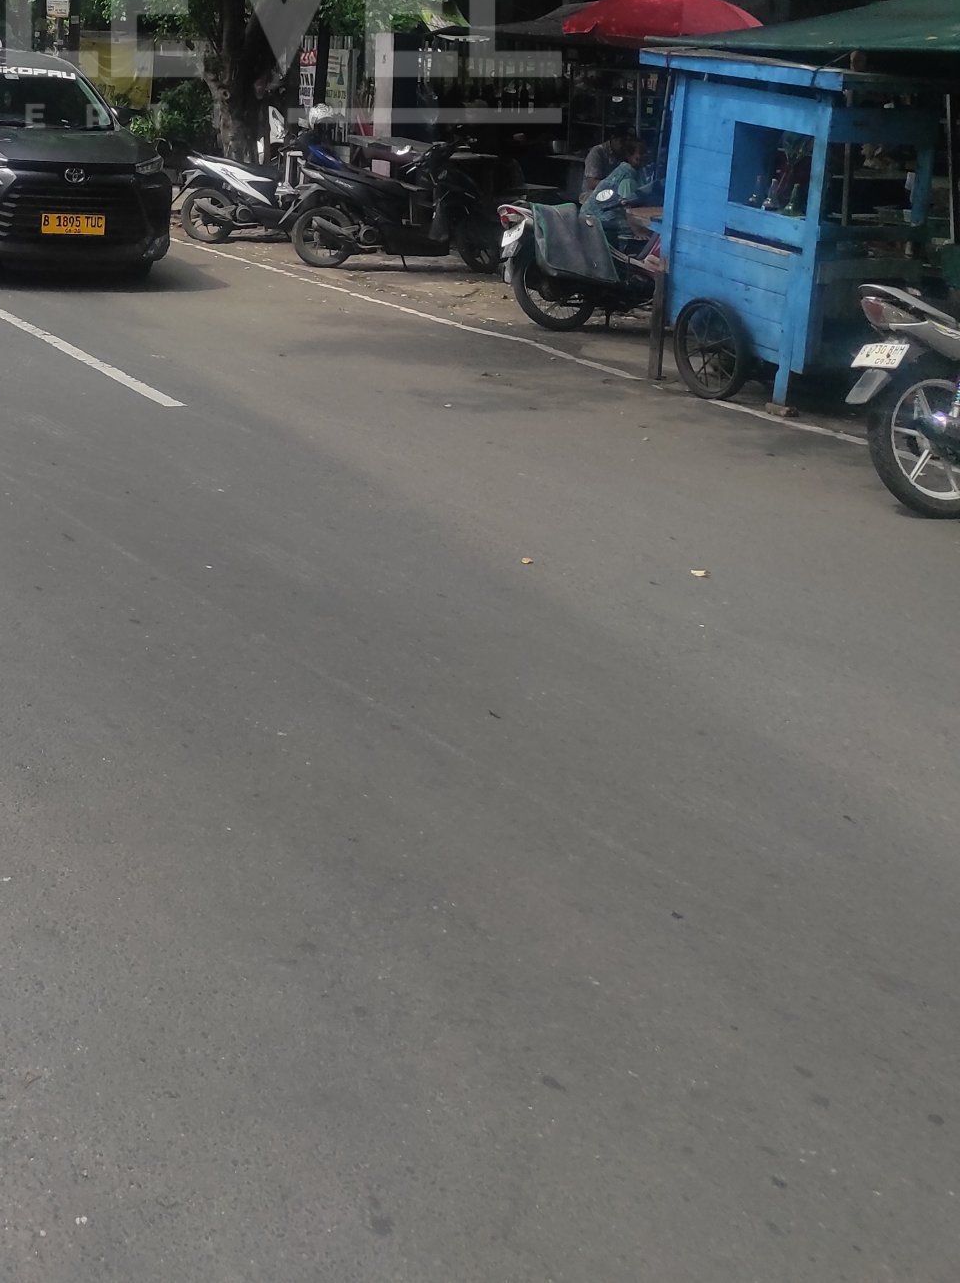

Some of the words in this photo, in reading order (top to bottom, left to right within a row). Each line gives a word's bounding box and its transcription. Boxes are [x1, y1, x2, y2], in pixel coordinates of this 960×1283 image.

[43, 215, 50, 226] B
[56, 215, 81, 228] 1895
[84, 217, 103, 228] TUC
